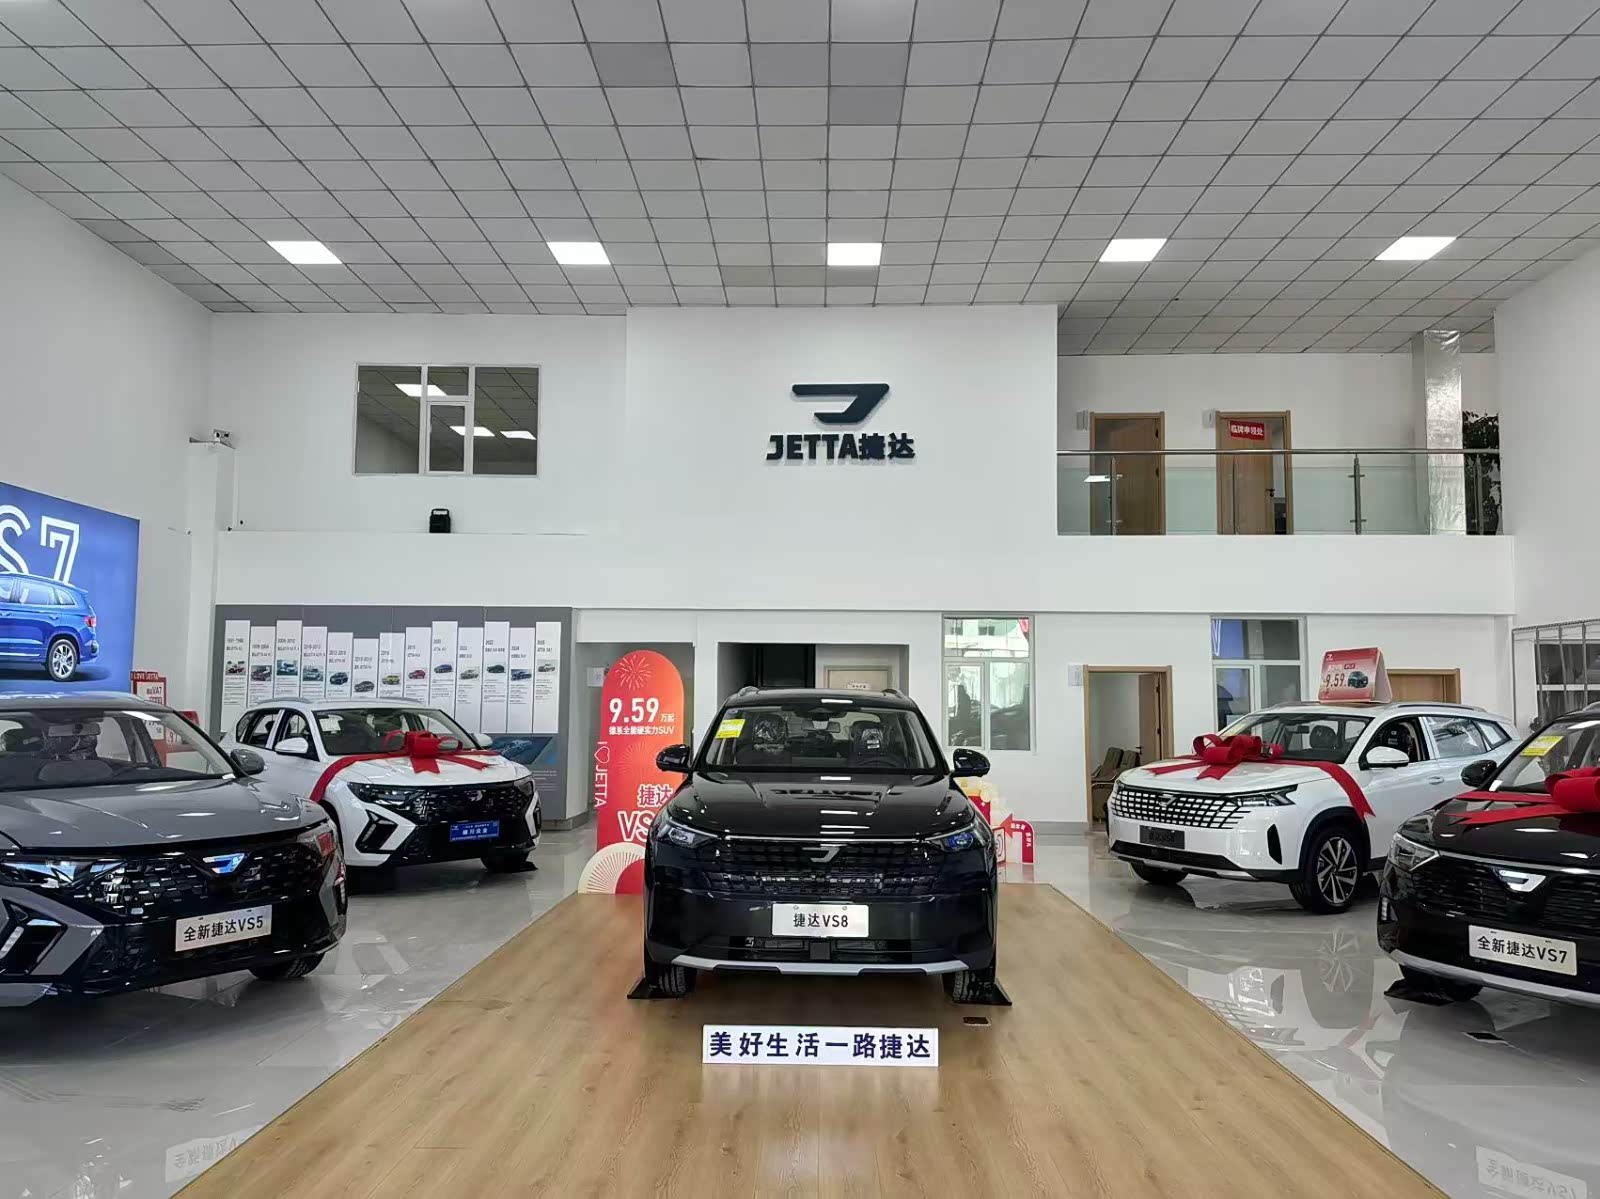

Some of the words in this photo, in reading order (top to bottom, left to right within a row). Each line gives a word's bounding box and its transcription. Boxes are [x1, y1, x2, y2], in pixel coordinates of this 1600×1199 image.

[609, 697, 660, 723] 9.59
[595, 765, 608, 808] JETTA
[617, 810, 655, 843] VS
[184, 915, 264, 942] 全新捷达VS5
[793, 912, 849, 930] 捷达VS8
[1477, 935, 1568, 964] 全新捷达VS7
[709, 1031, 931, 1059] 美好生活一路捷达
